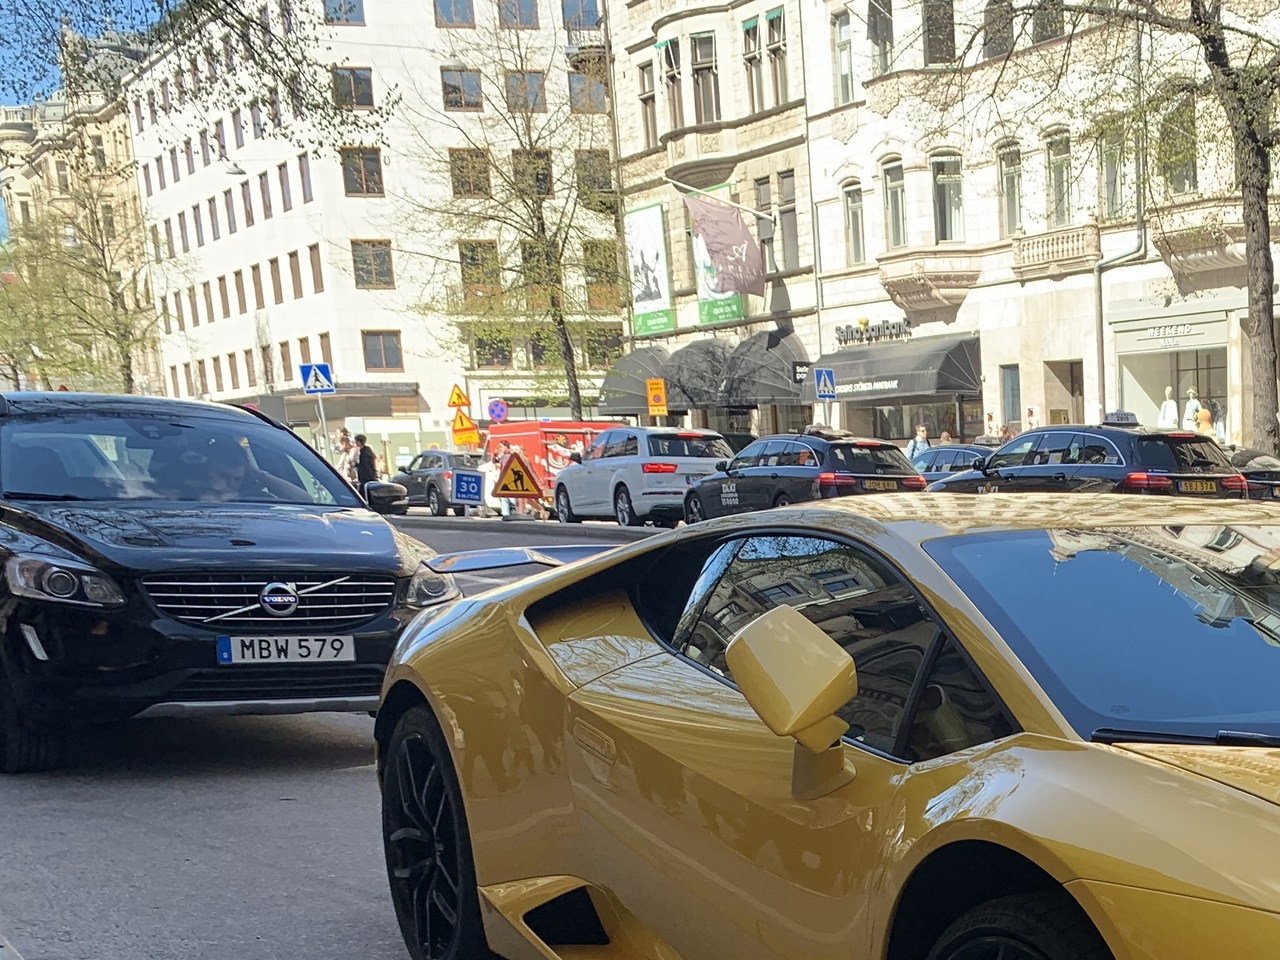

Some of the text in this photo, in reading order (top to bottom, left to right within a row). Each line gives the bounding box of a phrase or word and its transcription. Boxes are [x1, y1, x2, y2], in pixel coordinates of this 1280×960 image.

[1147, 324, 1192, 337] WEEKEND
[460, 481, 478, 493] 30
[240, 638, 289, 660] MBW
[298, 638, 344, 658] 579
